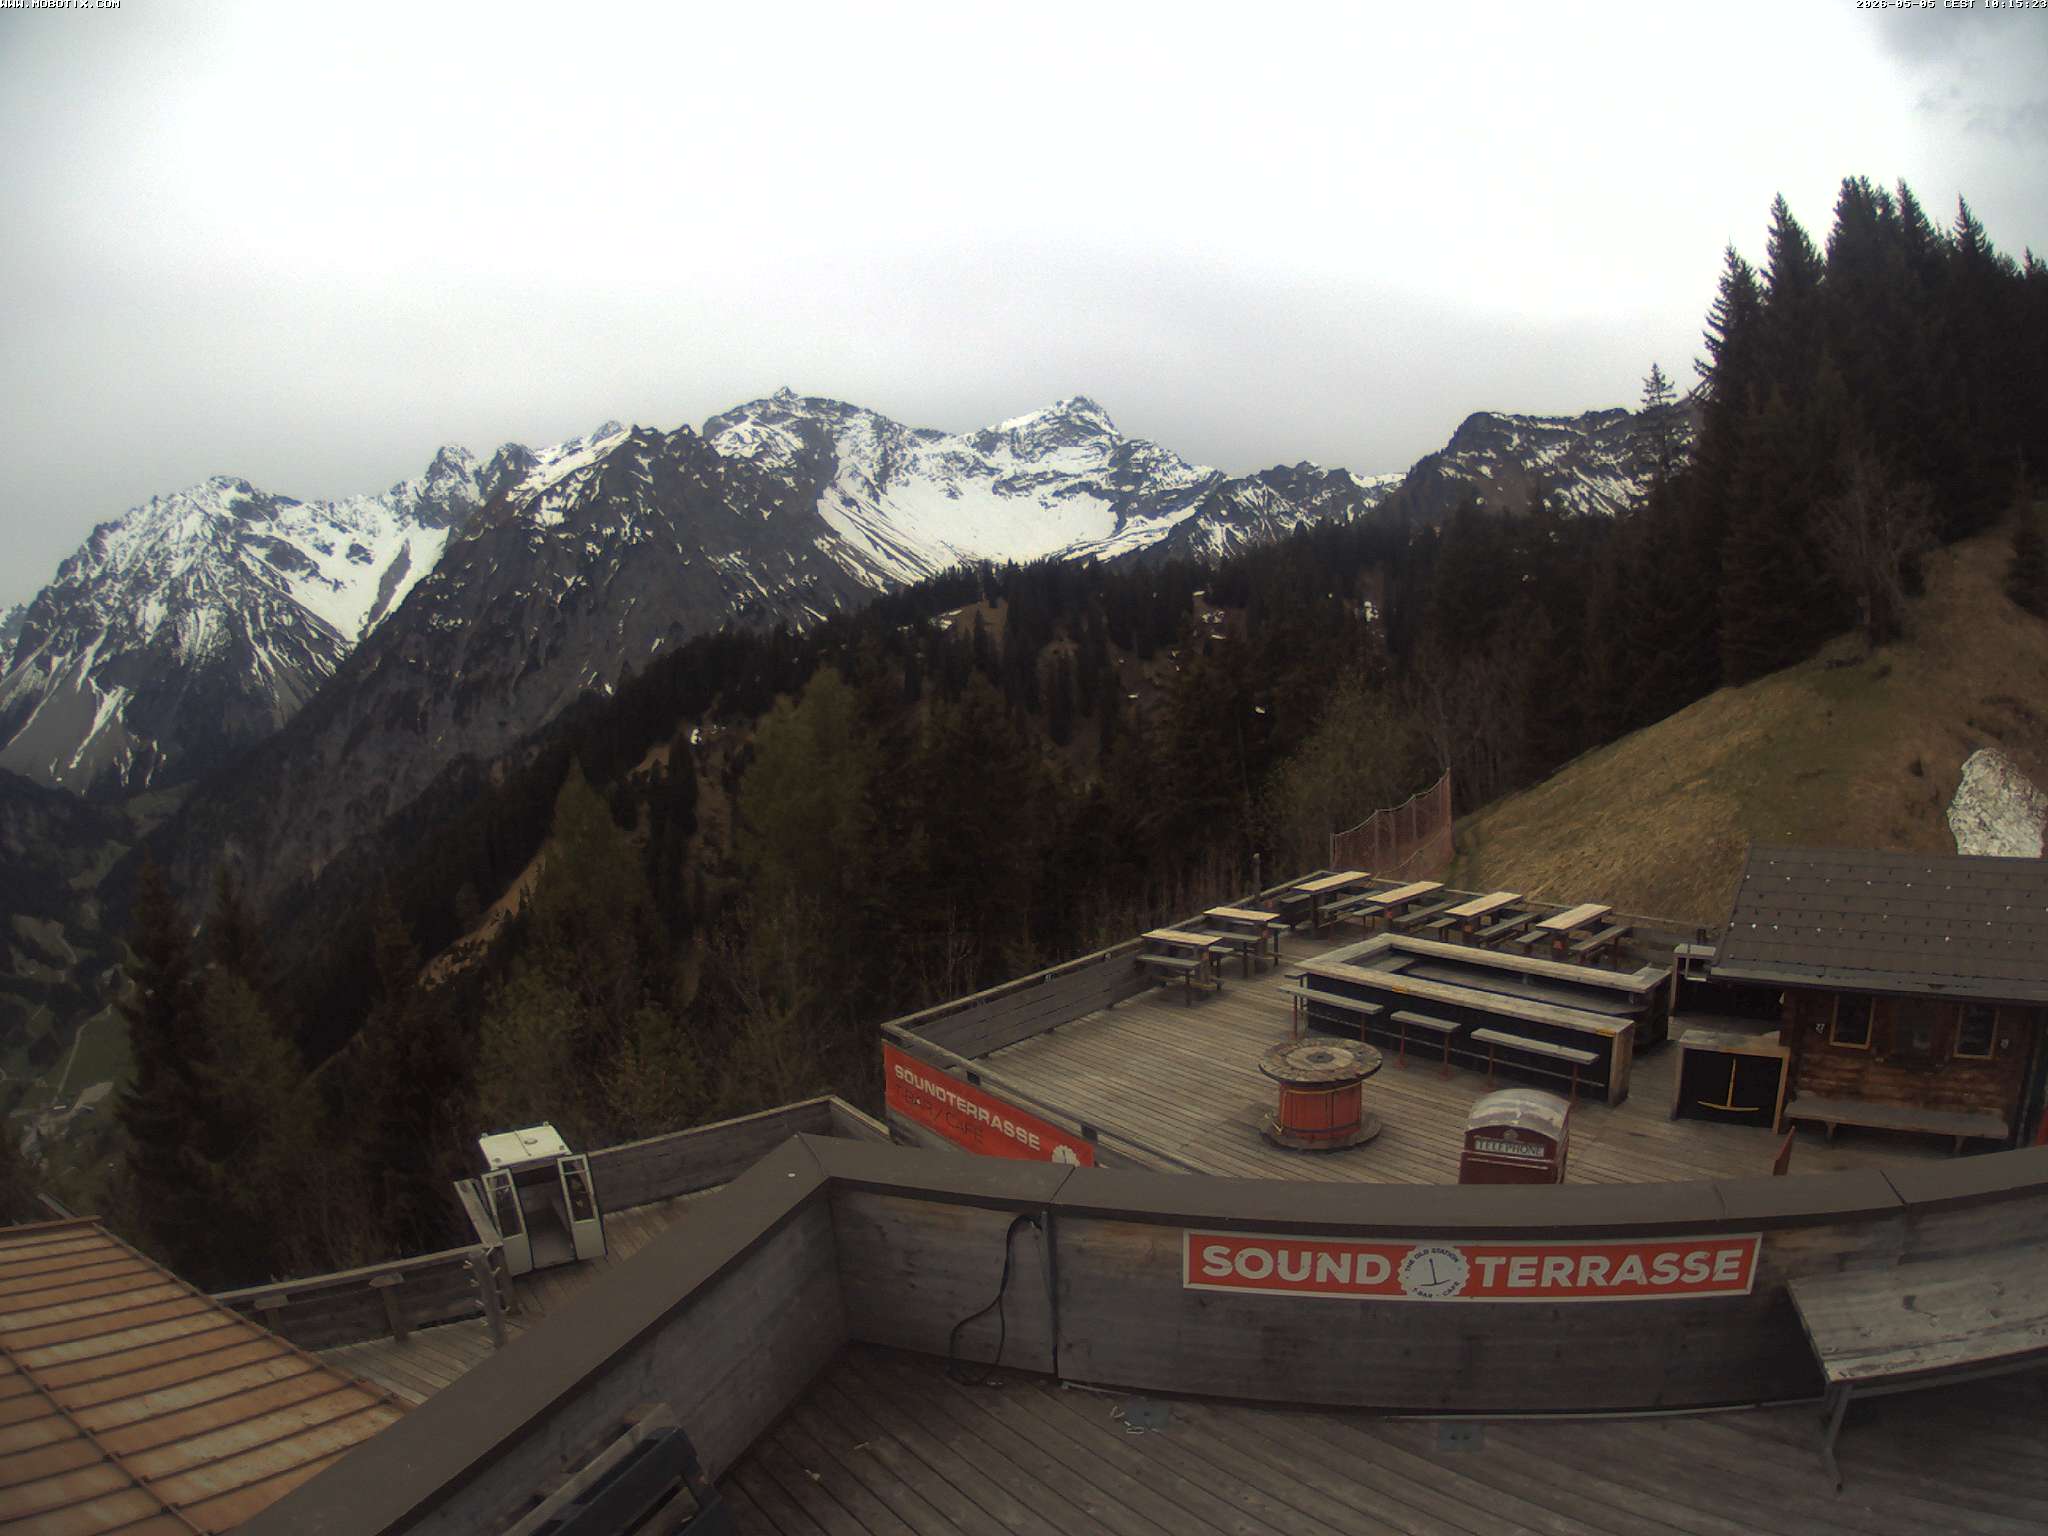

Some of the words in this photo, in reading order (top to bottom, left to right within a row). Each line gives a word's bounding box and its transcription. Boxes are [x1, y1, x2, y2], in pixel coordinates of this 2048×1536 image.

[894, 1064, 1041, 1151] SOUNDTERRASSE
[1479, 1140, 1545, 1156] TELEPHONE
[1203, 1245, 1391, 1284] SOUND
[1475, 1249, 1744, 1287] TERRASSE
